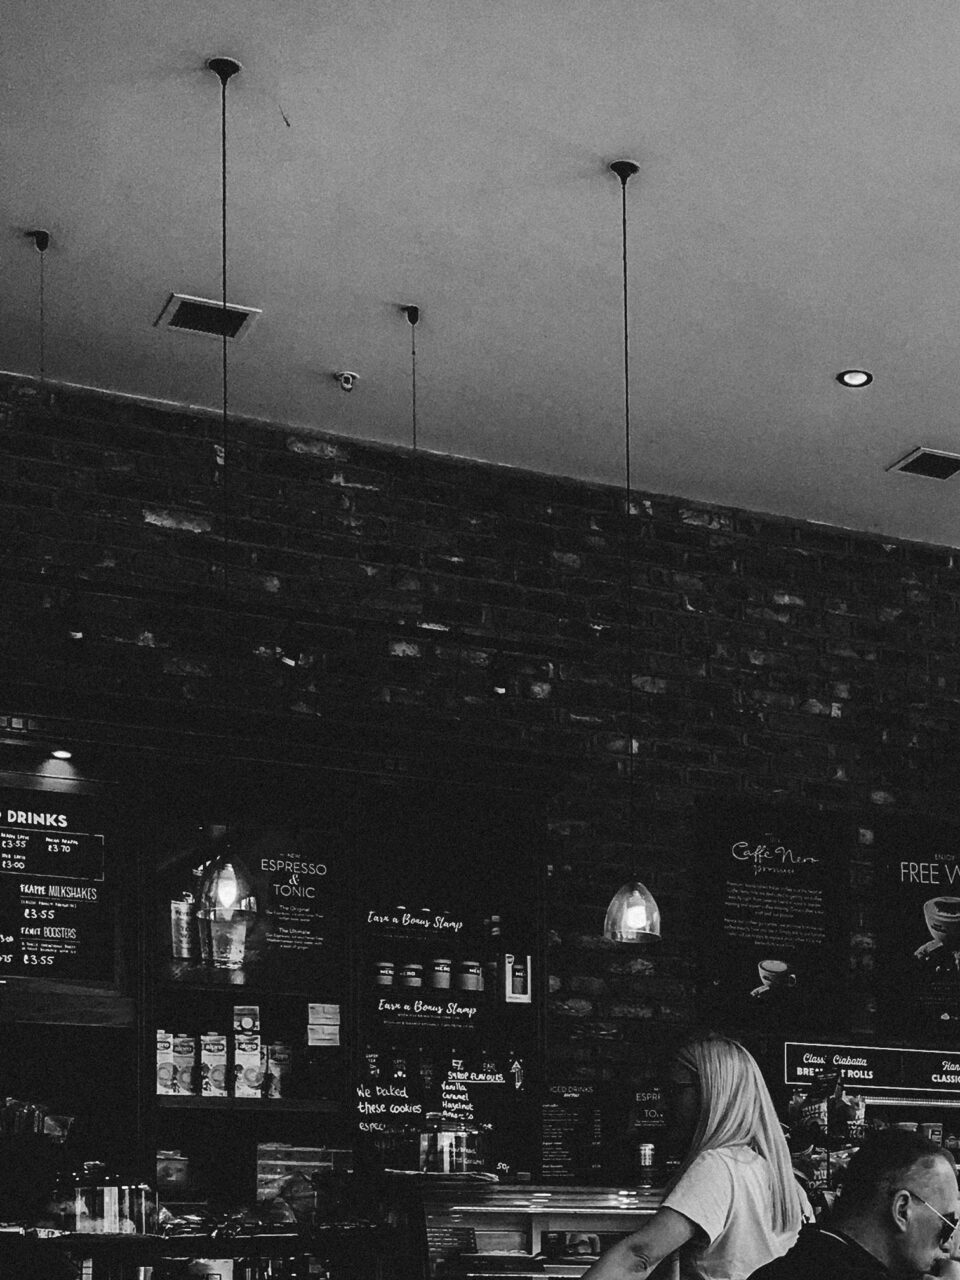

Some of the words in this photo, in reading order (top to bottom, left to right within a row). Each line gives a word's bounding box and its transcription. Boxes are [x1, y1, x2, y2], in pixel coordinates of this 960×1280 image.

[7, 809, 68, 828] DRINKS
[260, 858, 327, 876] ESPRESSO
[900, 861, 940, 885] FREE
[288, 874, 300, 886] &
[48, 884, 97, 900] MILKSHAKES
[272, 884, 316, 899] TONIC
[367, 910, 390, 923] Earn
[401, 913, 431, 928] Bonus
[433, 915, 464, 933] Stamp
[43, 926, 77, 939] BOOSTERS
[377, 998, 401, 1011] Earn
[413, 1000, 443, 1014] Bonus
[446, 1002, 477, 1018] Stamp
[205, 1043, 225, 1053] alpro
[238, 1042, 258, 1052] alpro
[832, 1053, 868, 1066] Ciabatta
[847, 1069, 874, 1079] ROLLS
[356, 1083, 372, 1098] We
[375, 1084, 409, 1099] baked
[441, 1081, 468, 1091] Vanilla
[442, 1092, 469, 1101] Caramel
[357, 1101, 387, 1115] these
[389, 1104, 422, 1114] cookies
[442, 1100, 474, 1111] Hazelnut
